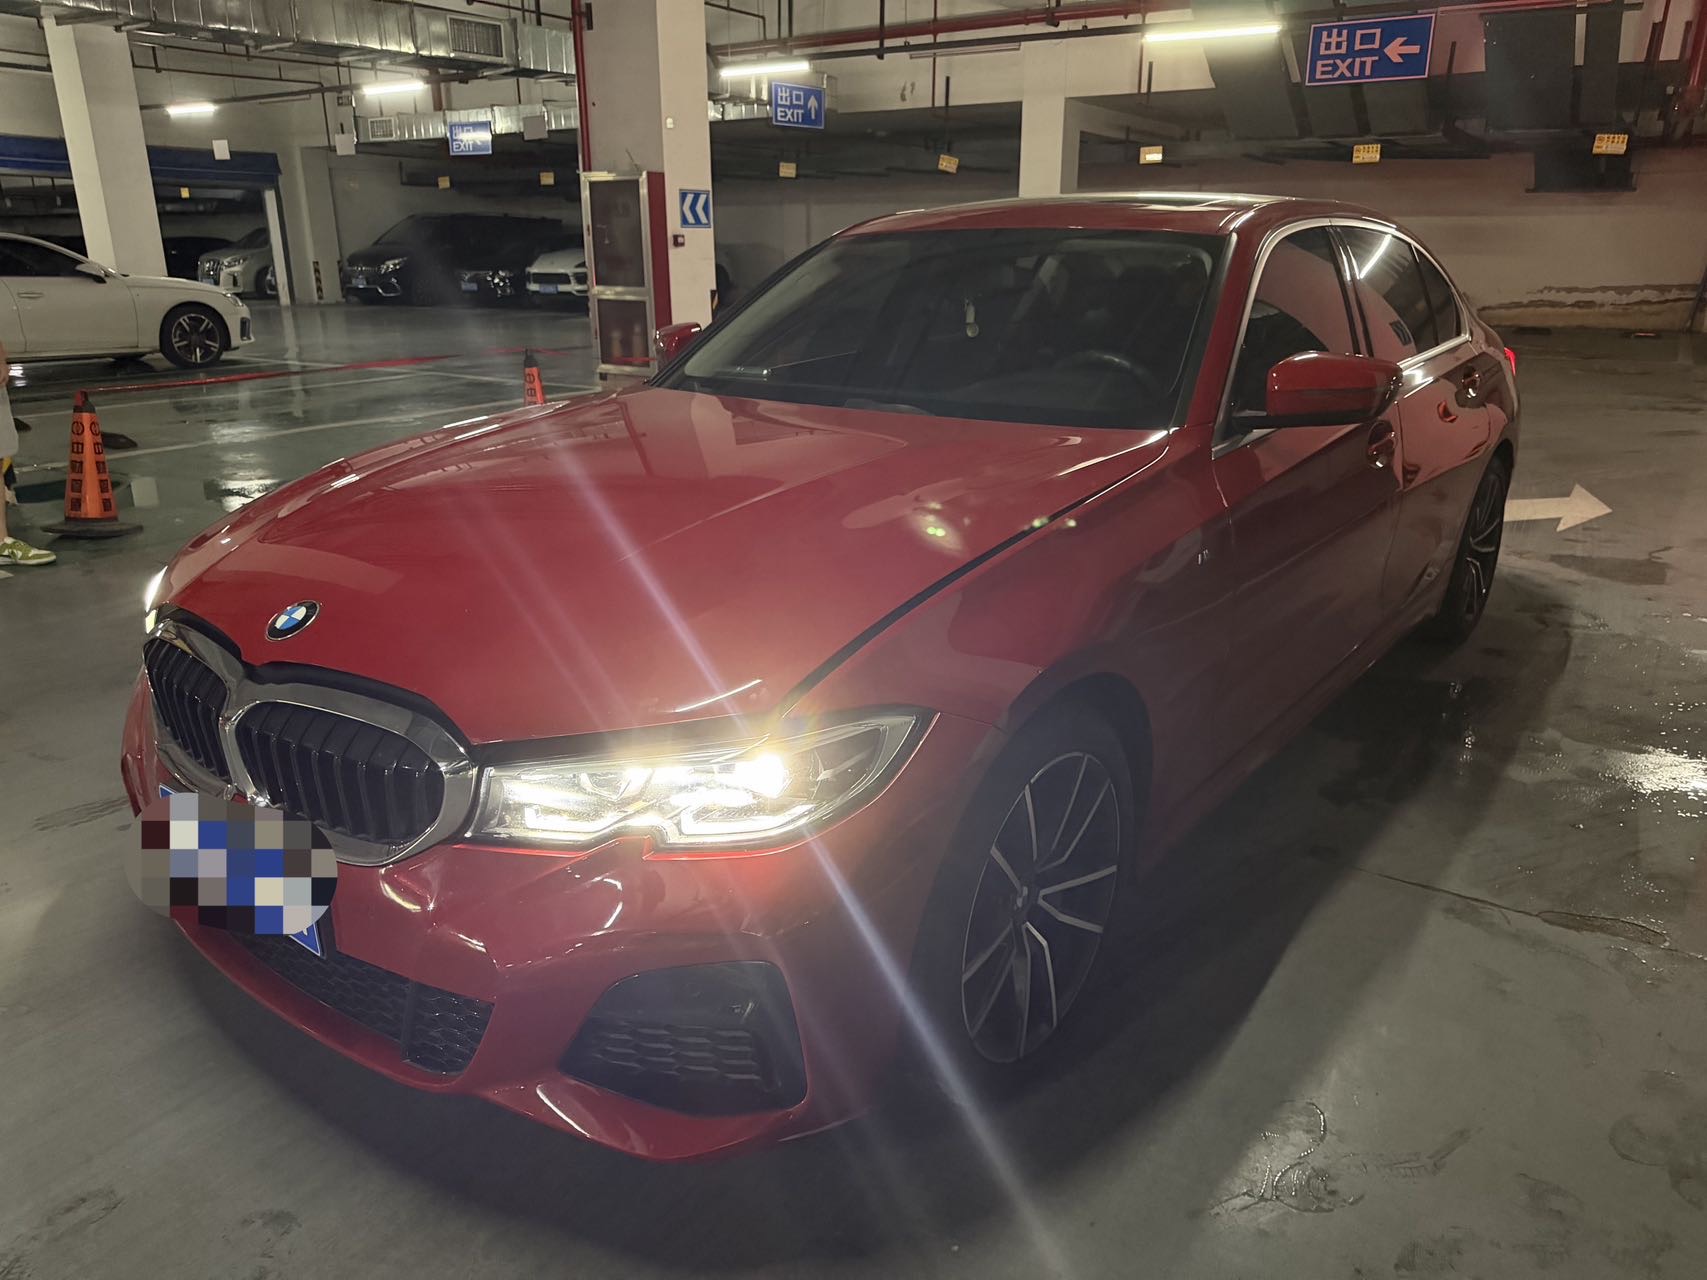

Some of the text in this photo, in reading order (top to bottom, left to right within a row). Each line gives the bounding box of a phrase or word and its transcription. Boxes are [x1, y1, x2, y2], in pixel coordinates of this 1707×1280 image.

[1319, 28, 1382, 56] 出口
[1315, 55, 1379, 79] EXIT
[777, 86, 804, 105] 出口
[776, 107, 805, 123] EXIT
[452, 140, 474, 152] EXIT
